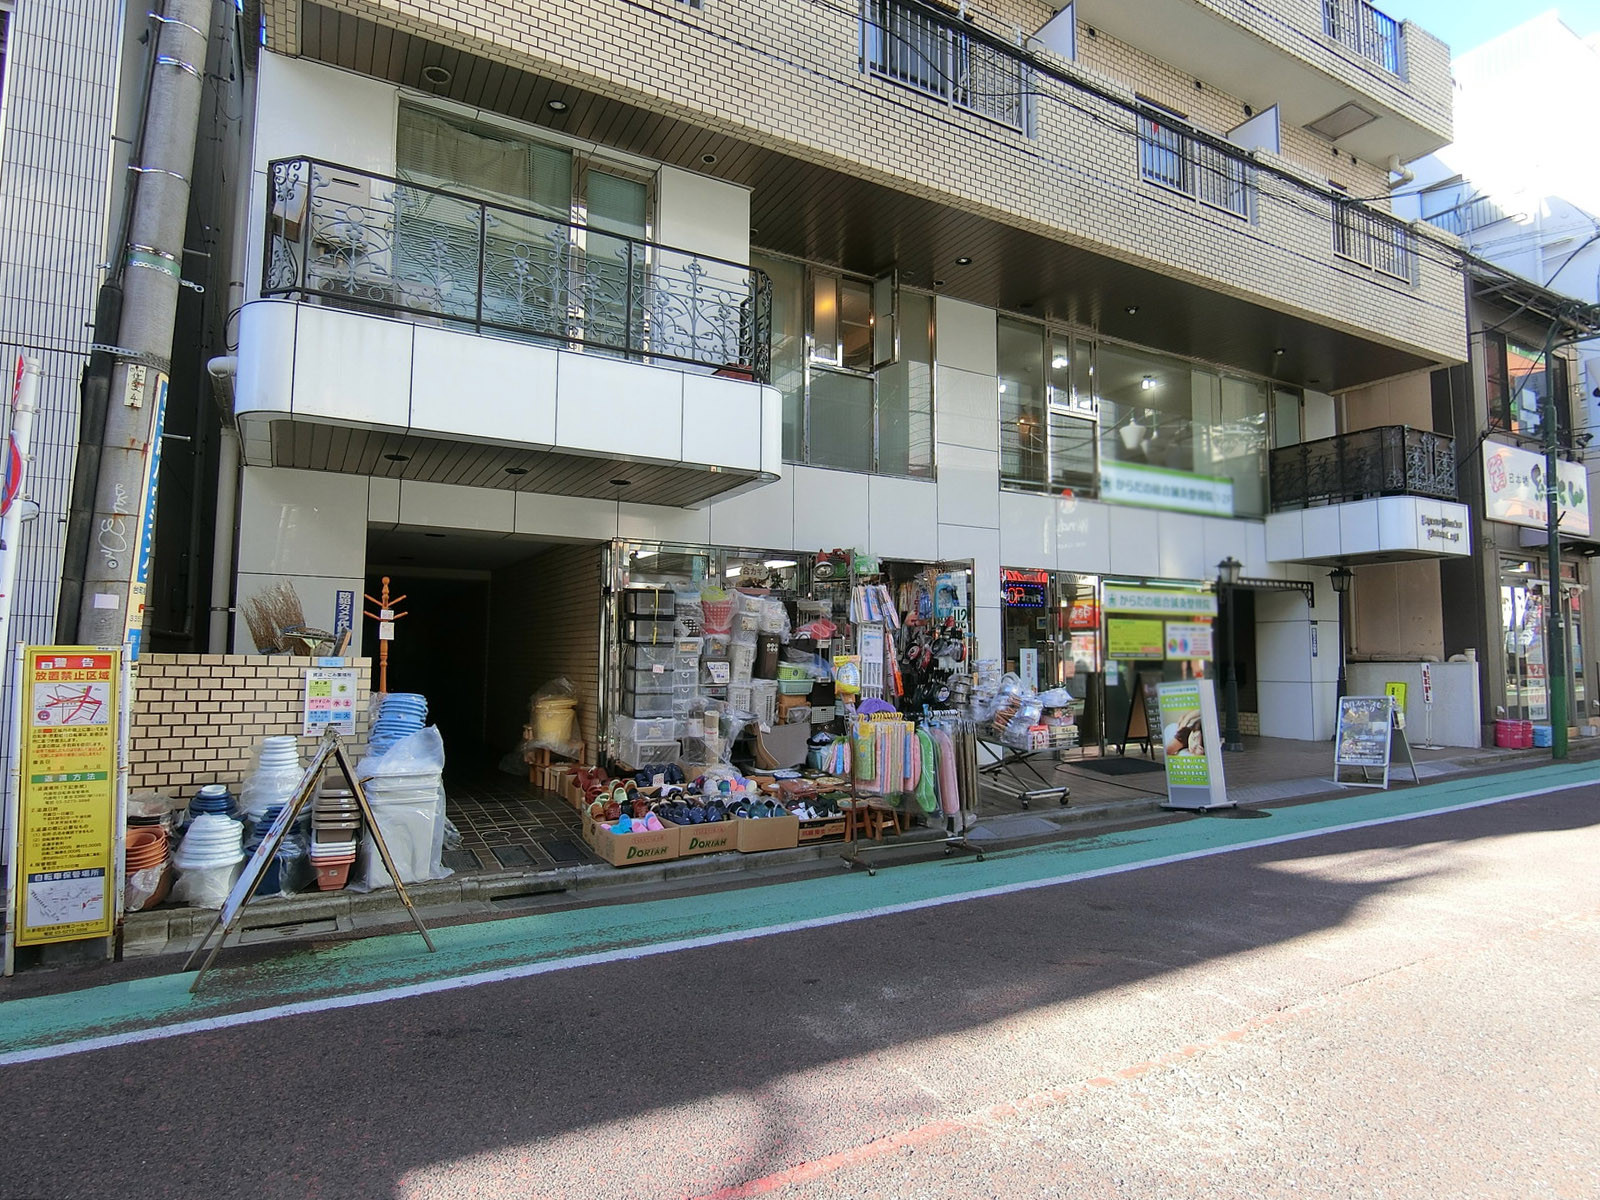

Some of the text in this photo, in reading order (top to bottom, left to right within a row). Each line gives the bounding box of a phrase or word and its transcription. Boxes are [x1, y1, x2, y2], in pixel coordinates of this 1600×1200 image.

[35, 671, 110, 681] 放置禁止区域
[34, 869, 100, 881] 自転車保管場所
